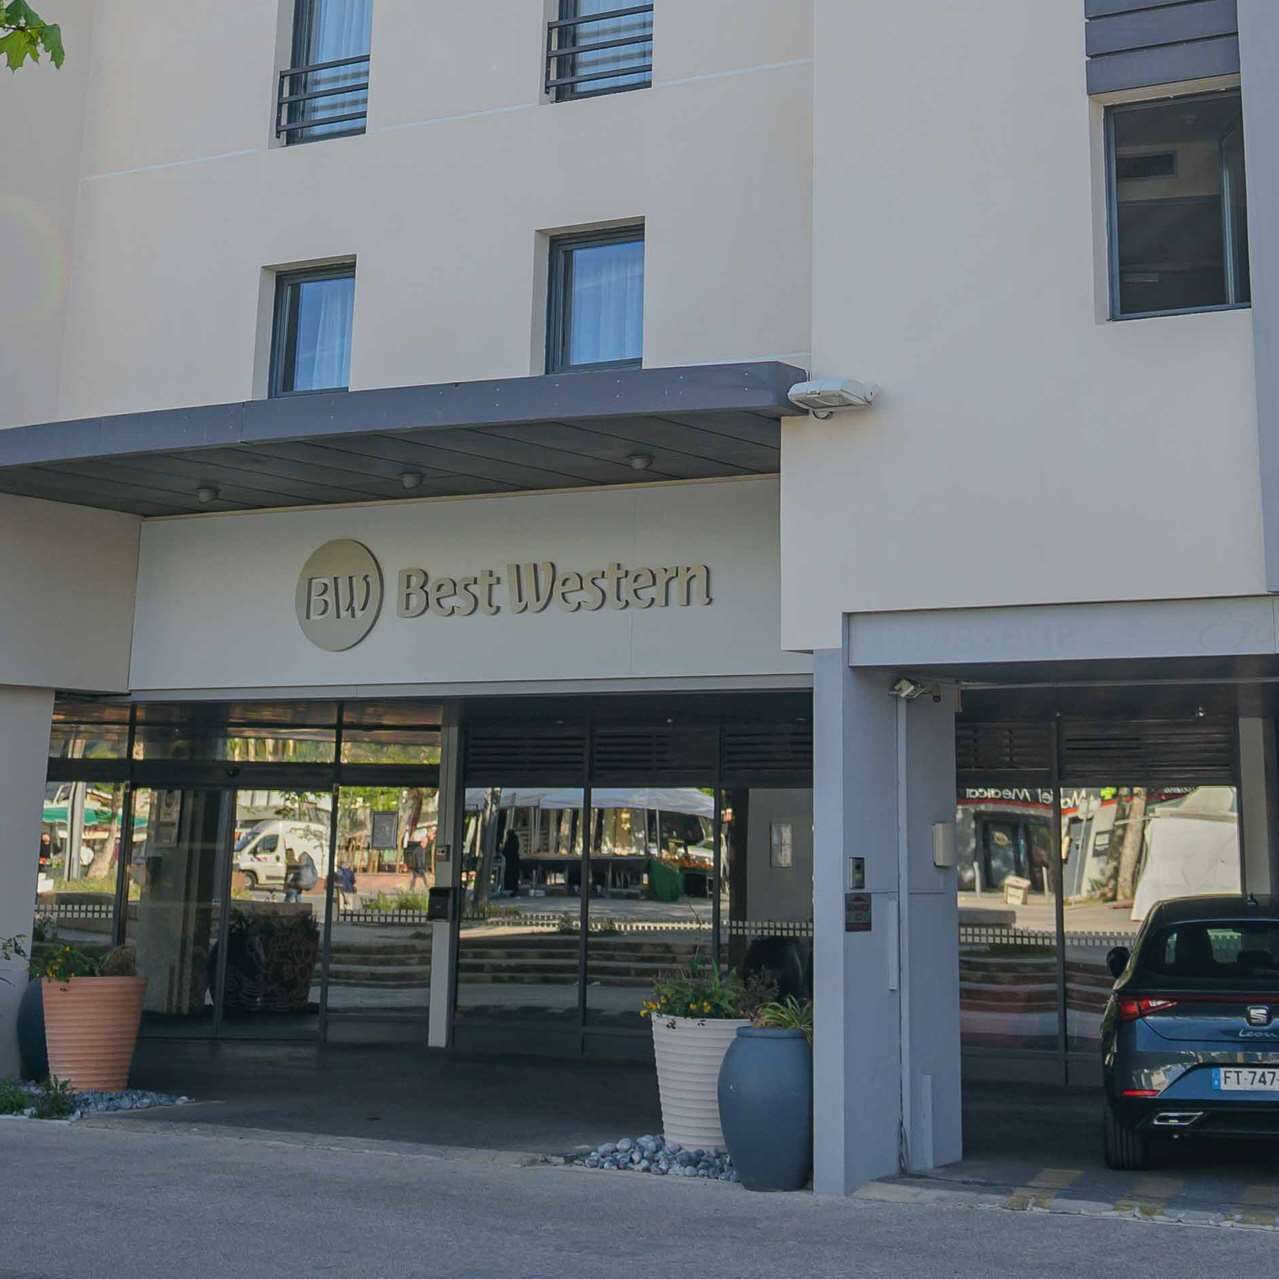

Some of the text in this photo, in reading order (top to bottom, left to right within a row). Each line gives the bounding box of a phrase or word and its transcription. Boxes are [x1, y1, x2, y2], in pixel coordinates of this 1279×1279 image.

[305, 574, 372, 620] BW
[397, 560, 714, 618] Best Western
